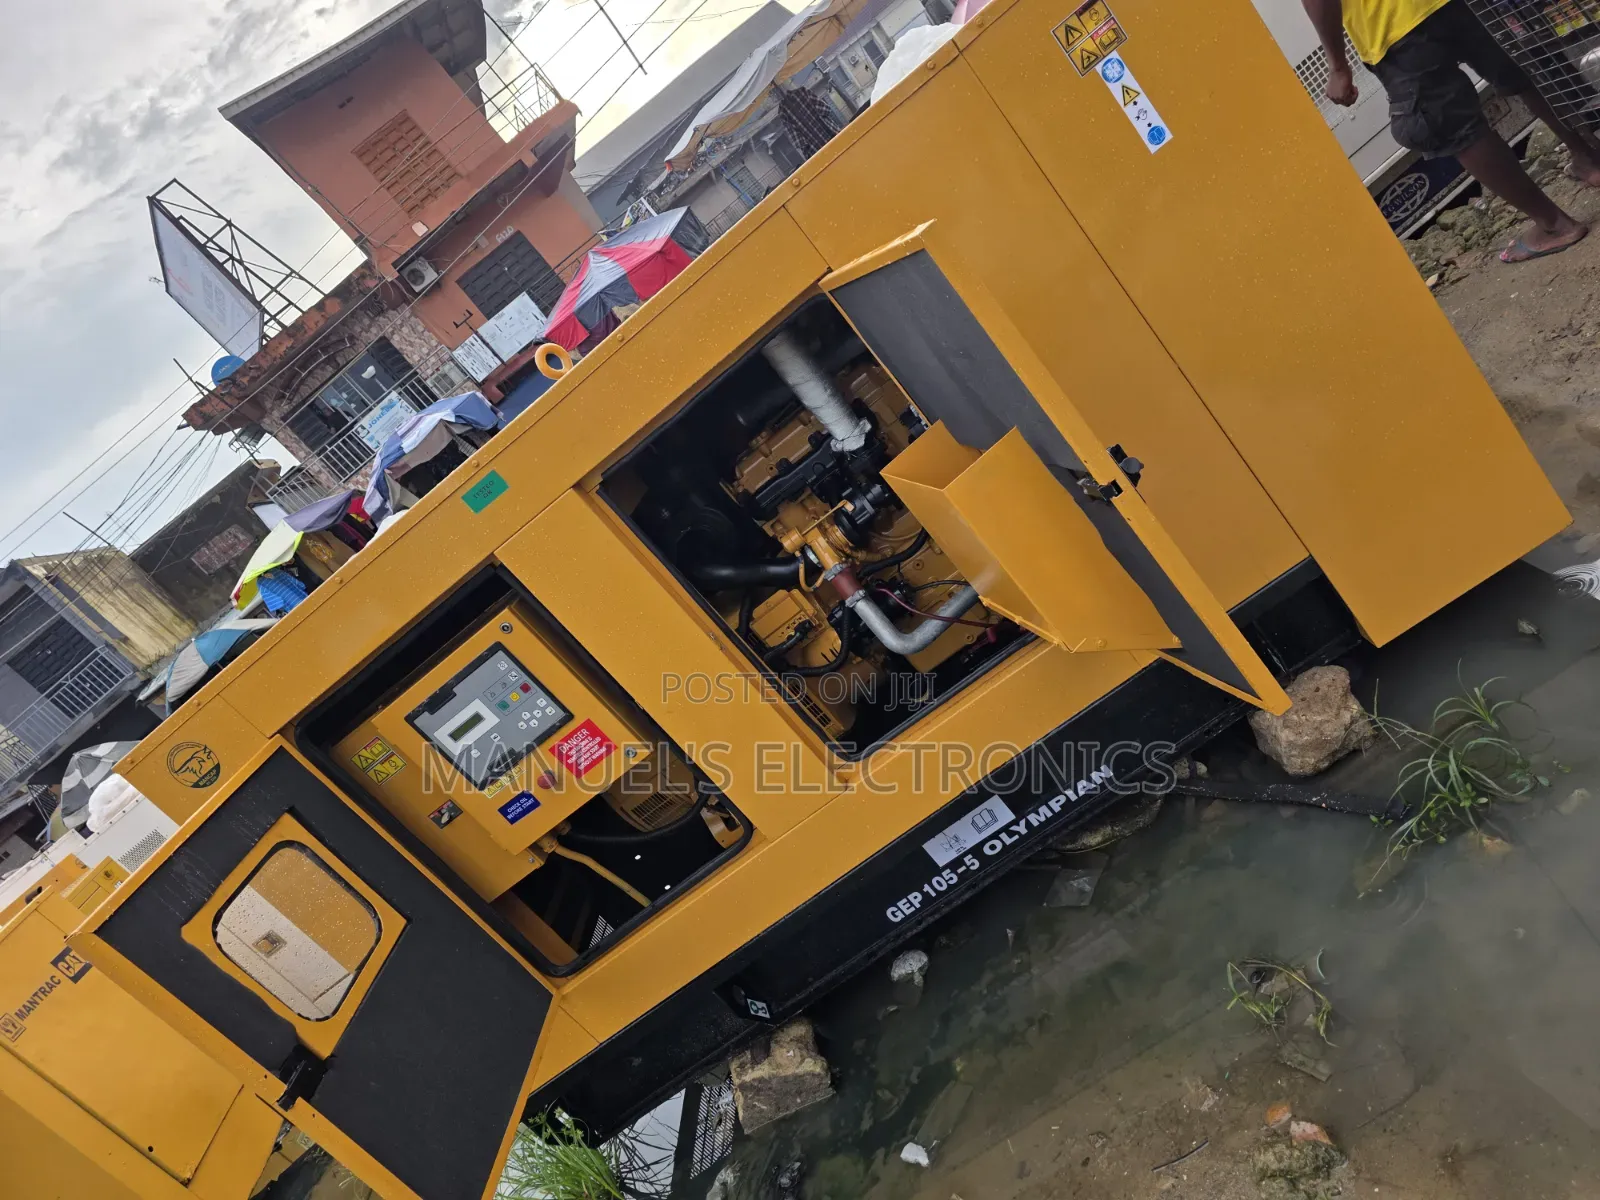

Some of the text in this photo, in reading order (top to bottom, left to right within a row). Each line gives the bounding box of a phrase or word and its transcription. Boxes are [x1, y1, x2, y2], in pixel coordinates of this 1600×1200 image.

[1394, 180, 1425, 205] WILSON
[558, 728, 590, 754] DANGER
[506, 797, 535, 820] BEFORE START
[507, 801, 521, 813] CHECK
[885, 764, 1114, 923] GEP 105-5 OLYMPIAN
[14, 975, 62, 1022] MANTRAC
